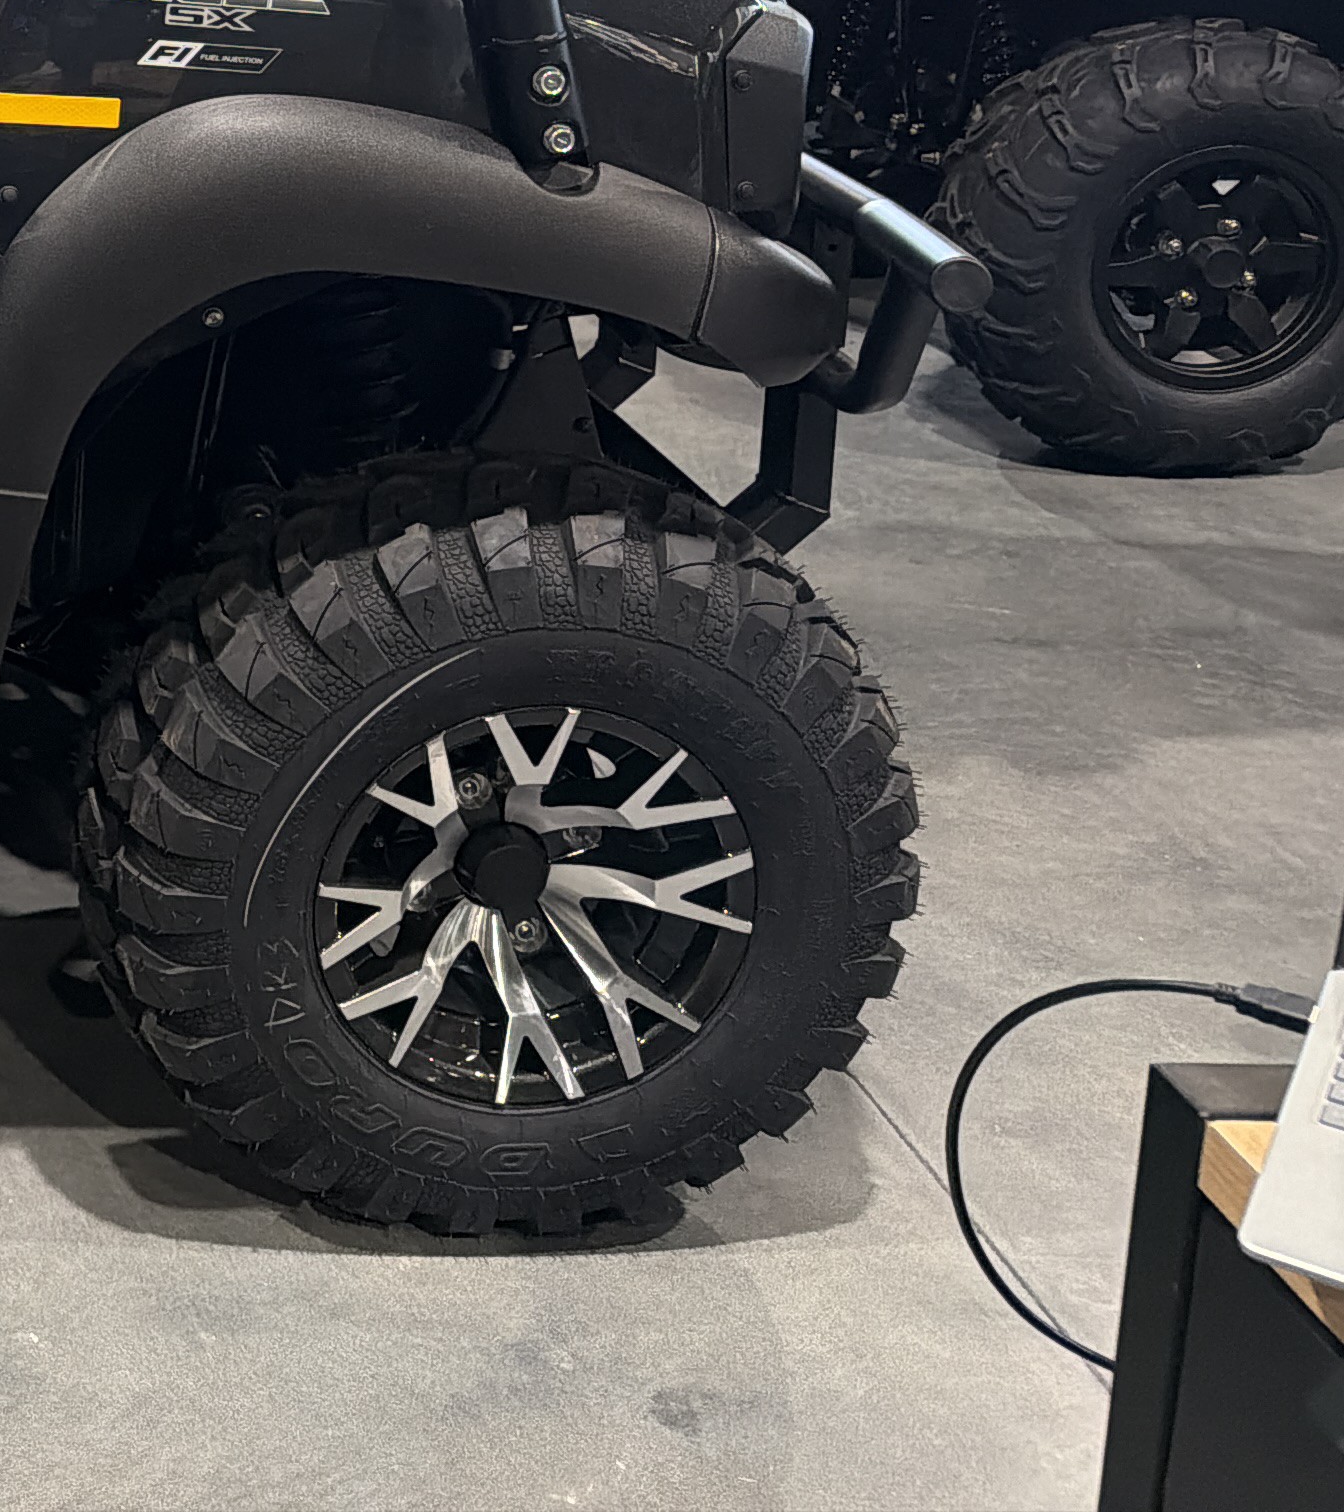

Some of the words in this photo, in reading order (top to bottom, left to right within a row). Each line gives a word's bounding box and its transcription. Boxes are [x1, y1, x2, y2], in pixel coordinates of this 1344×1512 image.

[164, 3, 258, 32] SX
[146, 44, 200, 63] FI
[199, 52, 221, 63] FUEL
[221, 55, 264, 66] INJECTION
